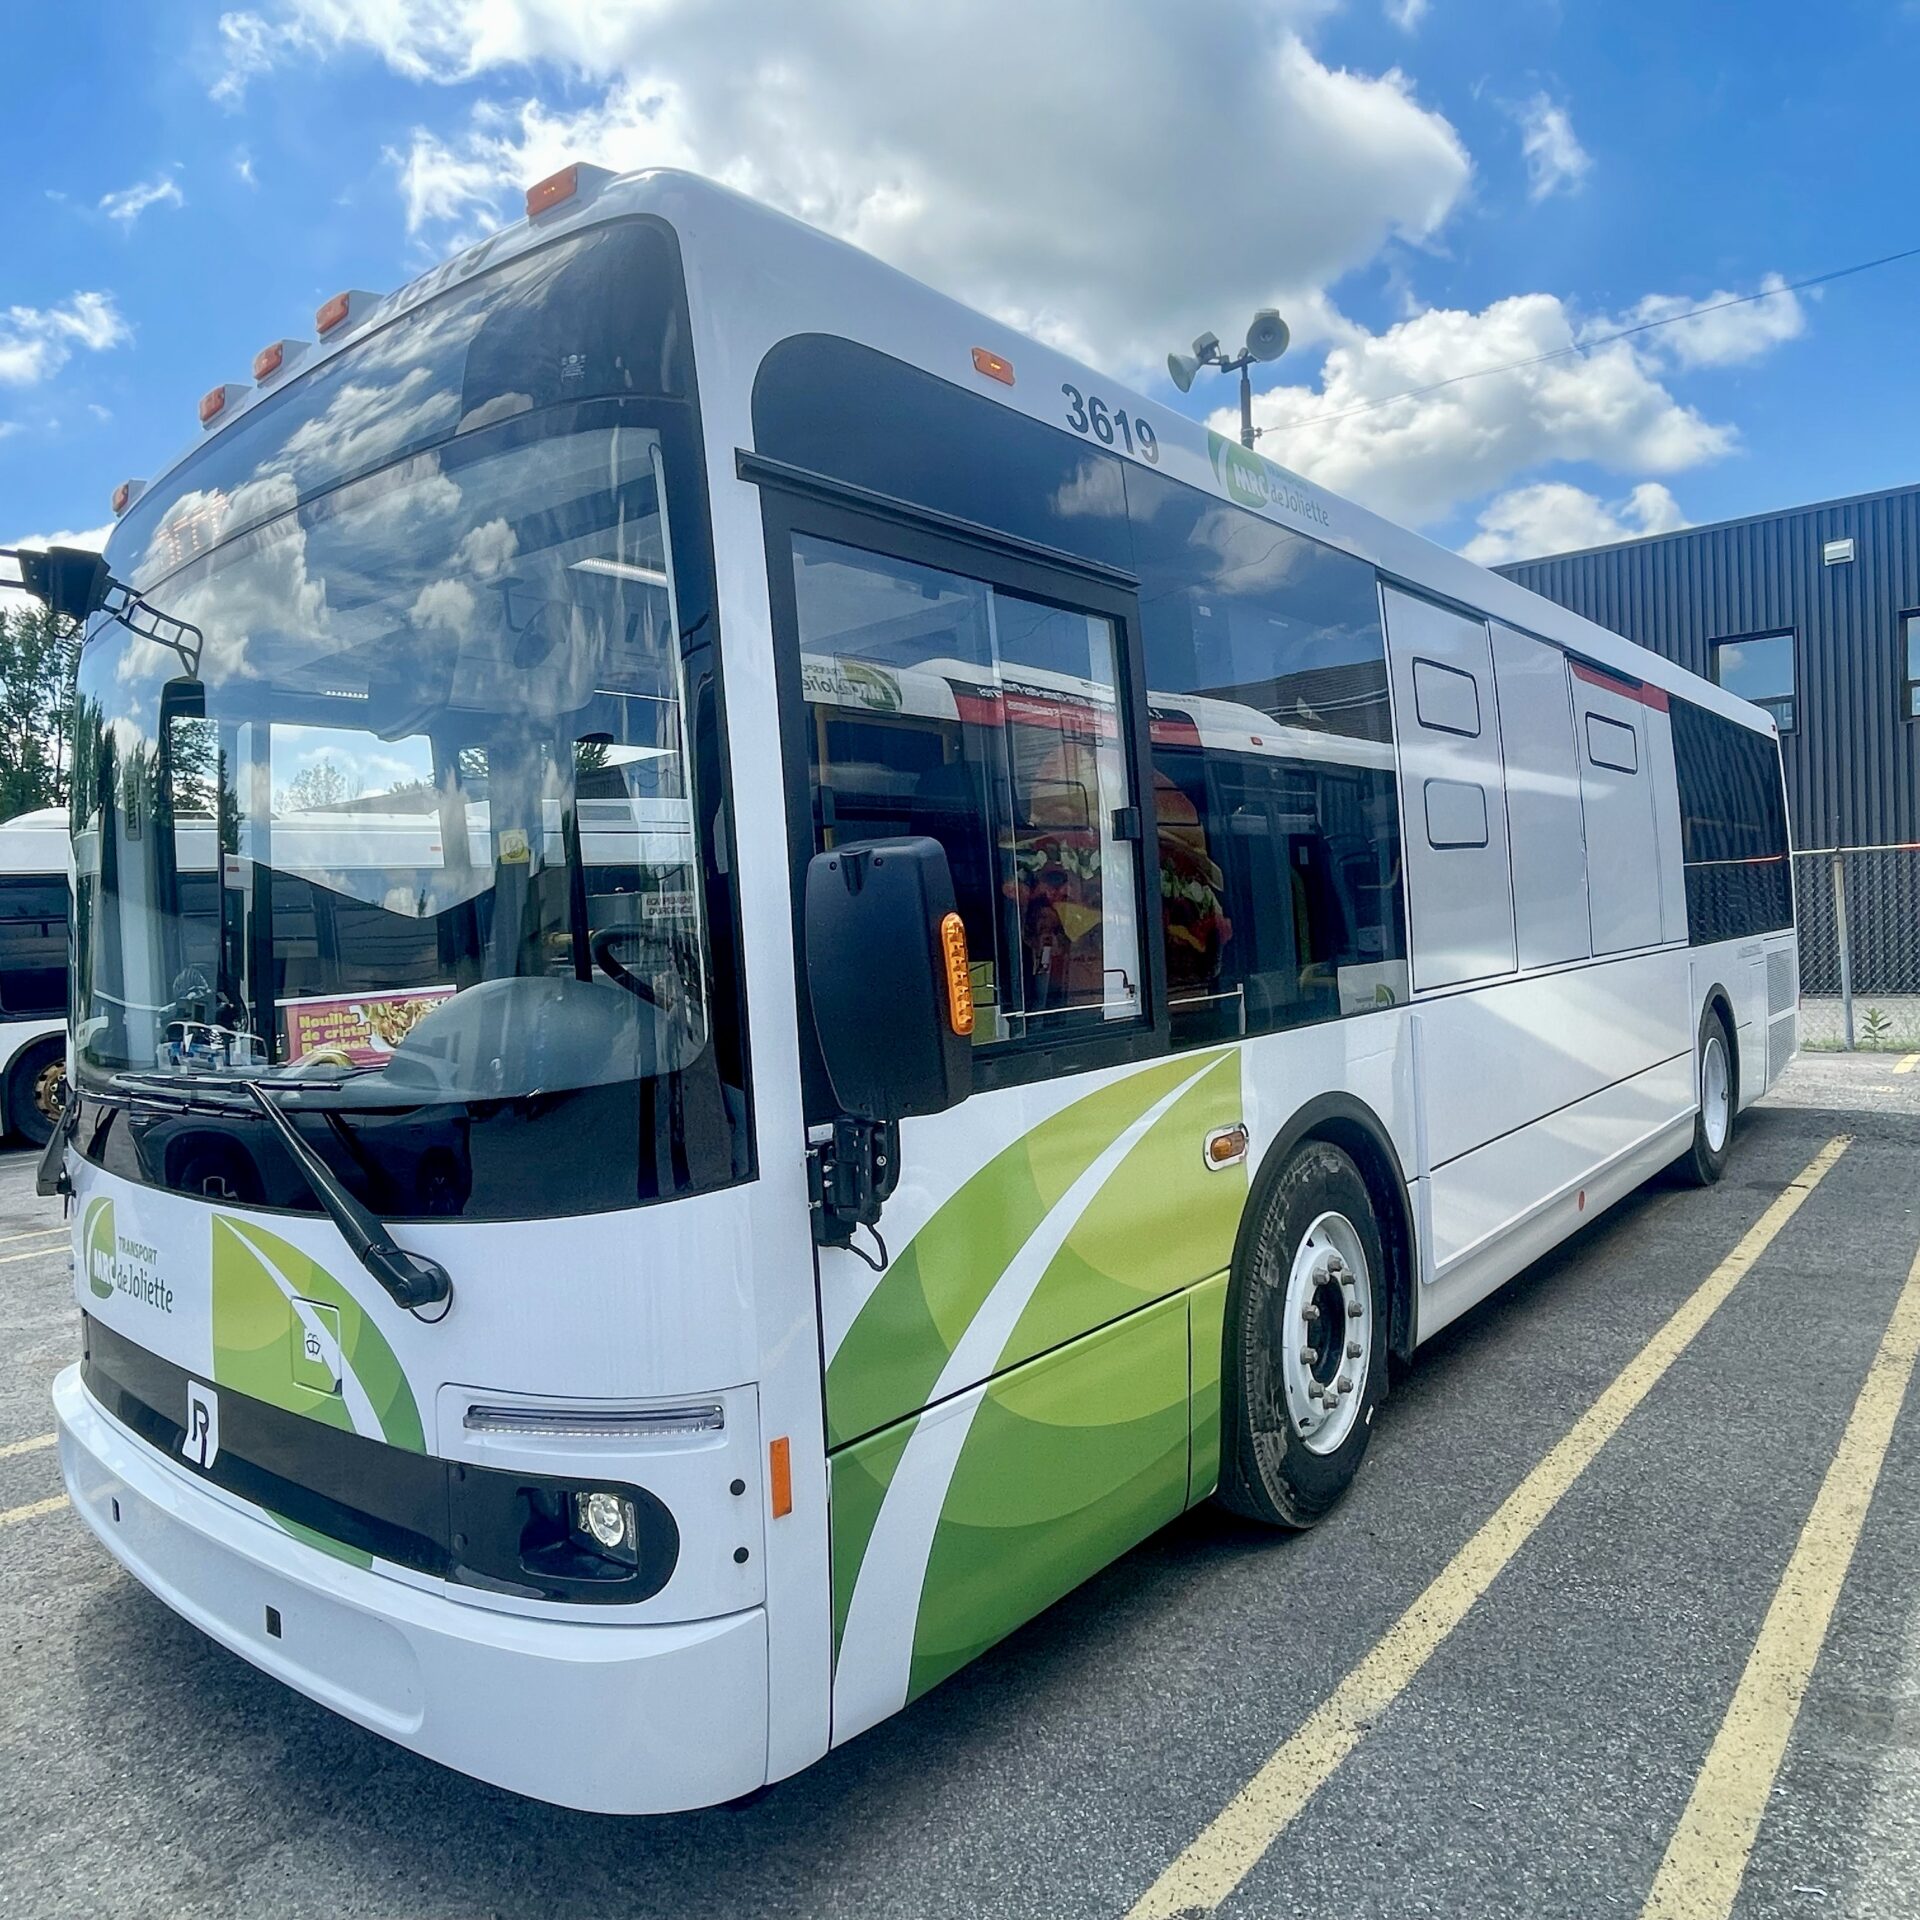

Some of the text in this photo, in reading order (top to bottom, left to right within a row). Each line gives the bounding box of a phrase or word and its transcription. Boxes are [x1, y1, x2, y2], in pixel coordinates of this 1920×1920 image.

[1061, 383, 1160, 465] 3619
[1232, 462, 1268, 498] MRC
[1284, 486, 1330, 527] Joliette
[299, 1012, 359, 1029] Nouilles
[301, 1021, 371, 1042] de cristal
[302, 1036, 371, 1056] Bkok
[93, 1247, 116, 1291] MRC
[118, 1236, 158, 1266] TRANSPORT
[128, 1264, 174, 1314] Joliette
